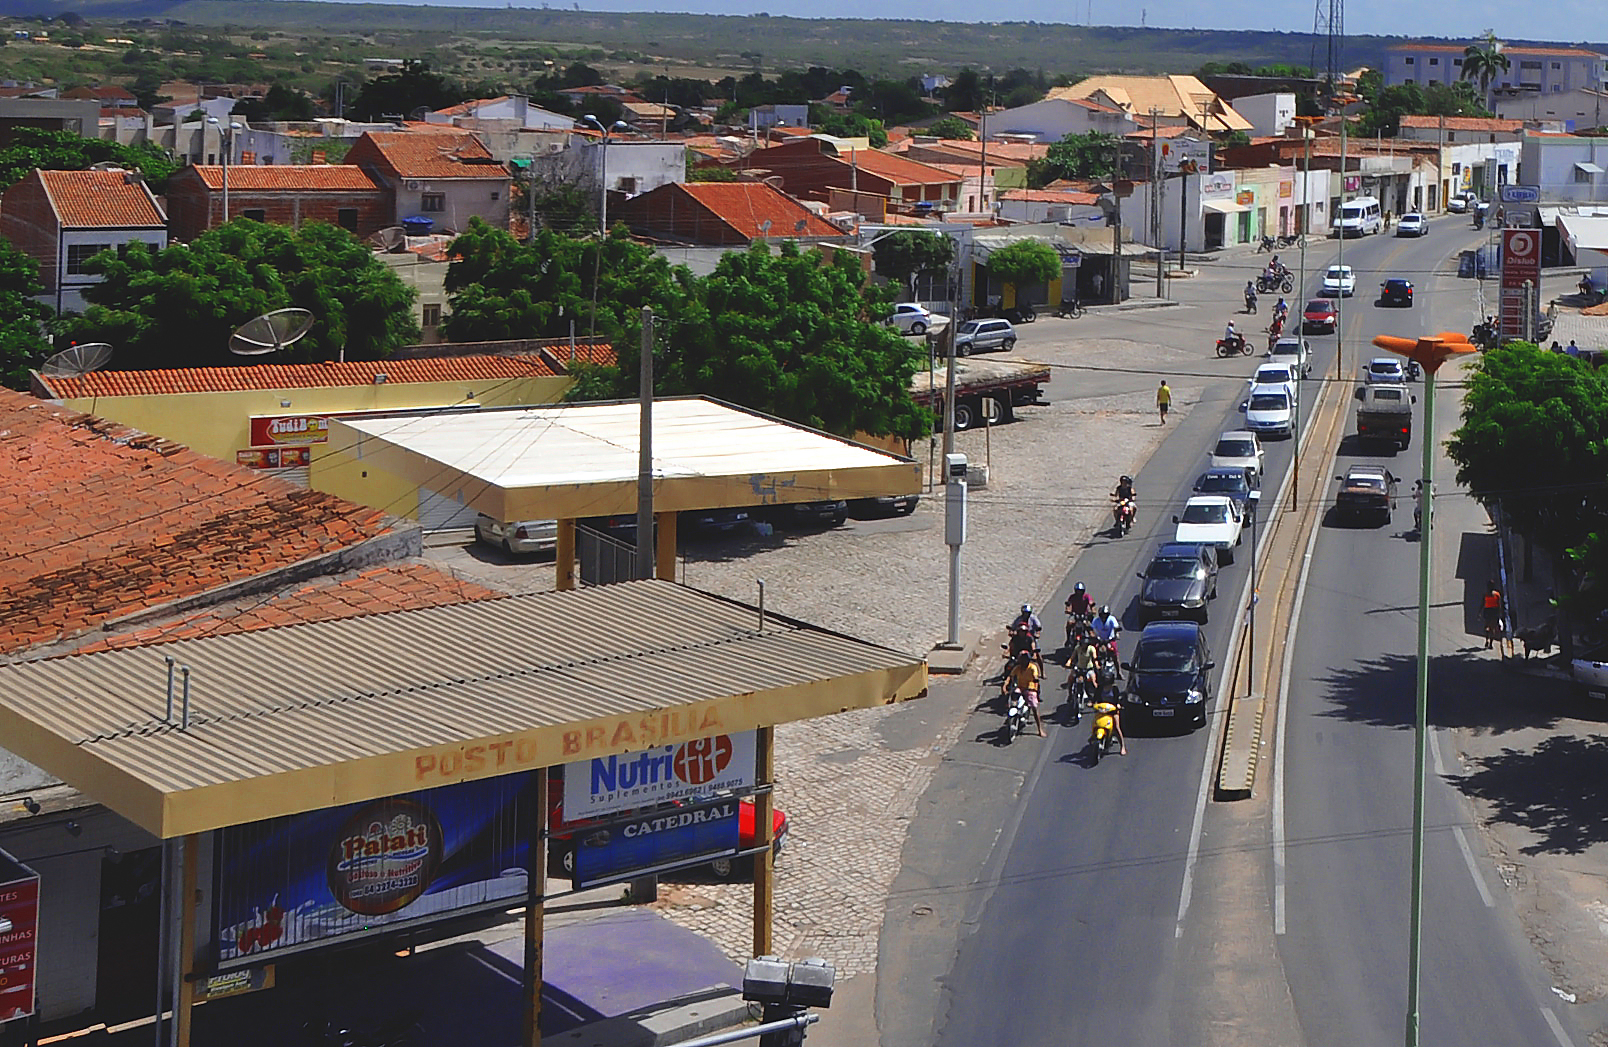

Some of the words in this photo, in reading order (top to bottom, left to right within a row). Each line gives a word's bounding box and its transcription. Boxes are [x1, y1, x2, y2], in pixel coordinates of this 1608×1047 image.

[1506, 256, 1536, 265] Dislub
[415, 738, 538, 782] POSTO
[590, 780, 681, 804] Suplementos
[623, 804, 734, 838] CATEDRAL
